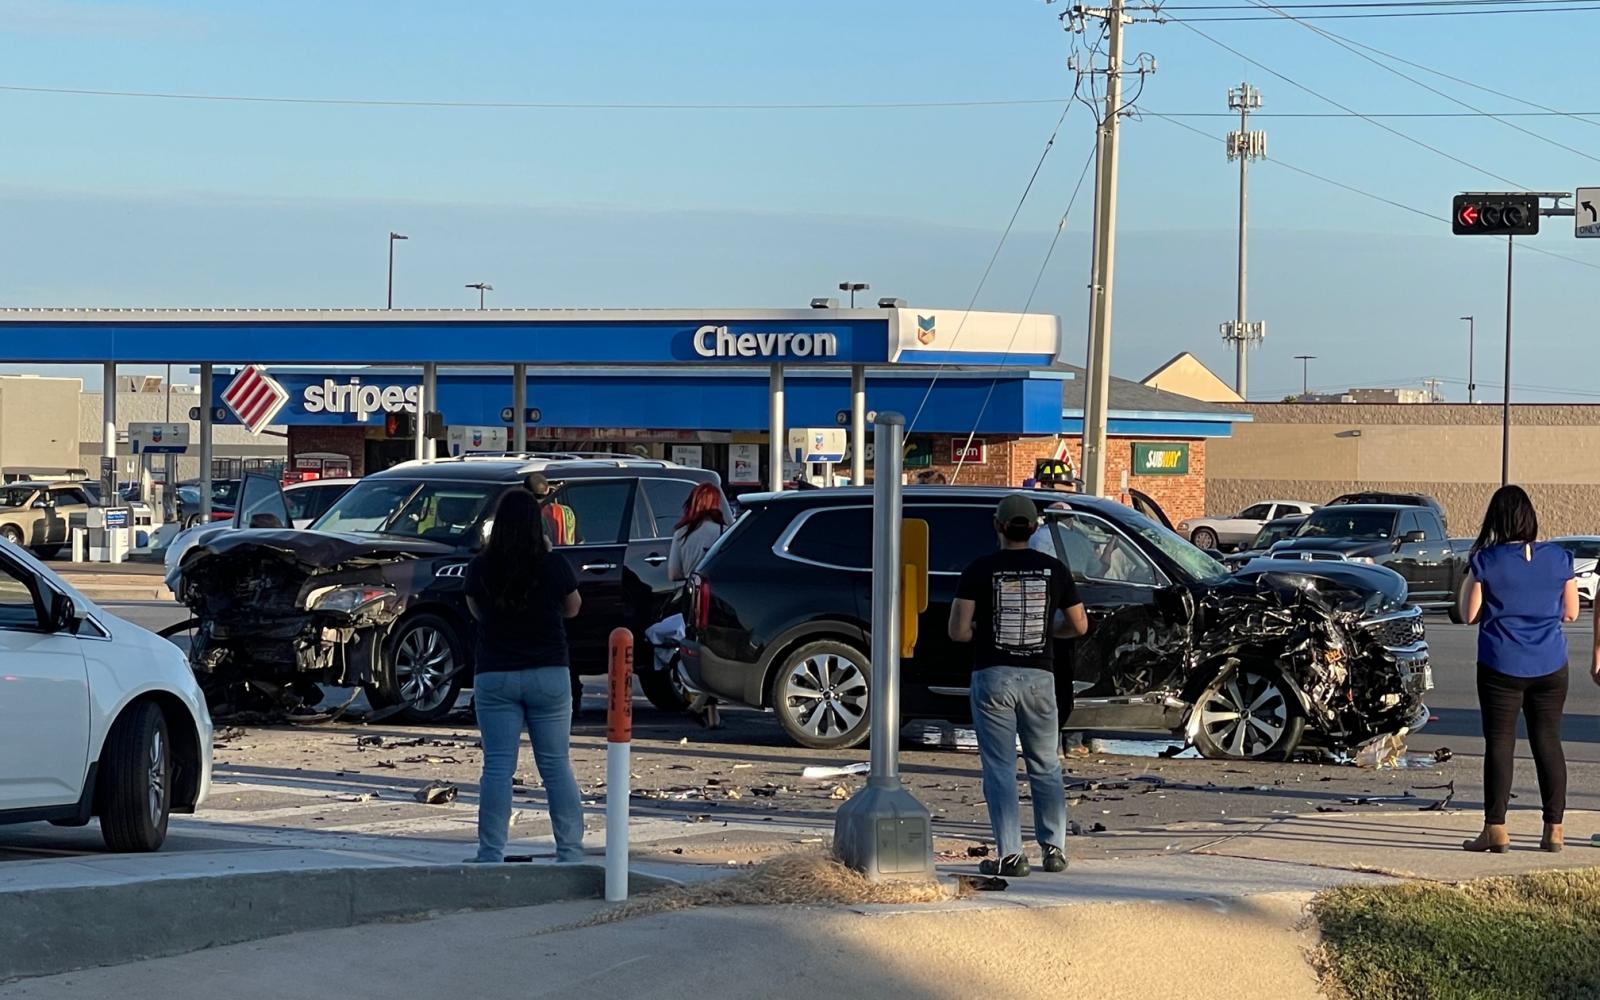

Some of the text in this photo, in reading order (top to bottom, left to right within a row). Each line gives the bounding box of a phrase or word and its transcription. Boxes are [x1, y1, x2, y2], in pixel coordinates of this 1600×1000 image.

[694, 325, 836, 357] Chevron
[303, 376, 418, 421] stripes
[1145, 450, 1181, 469] SUBWAY
